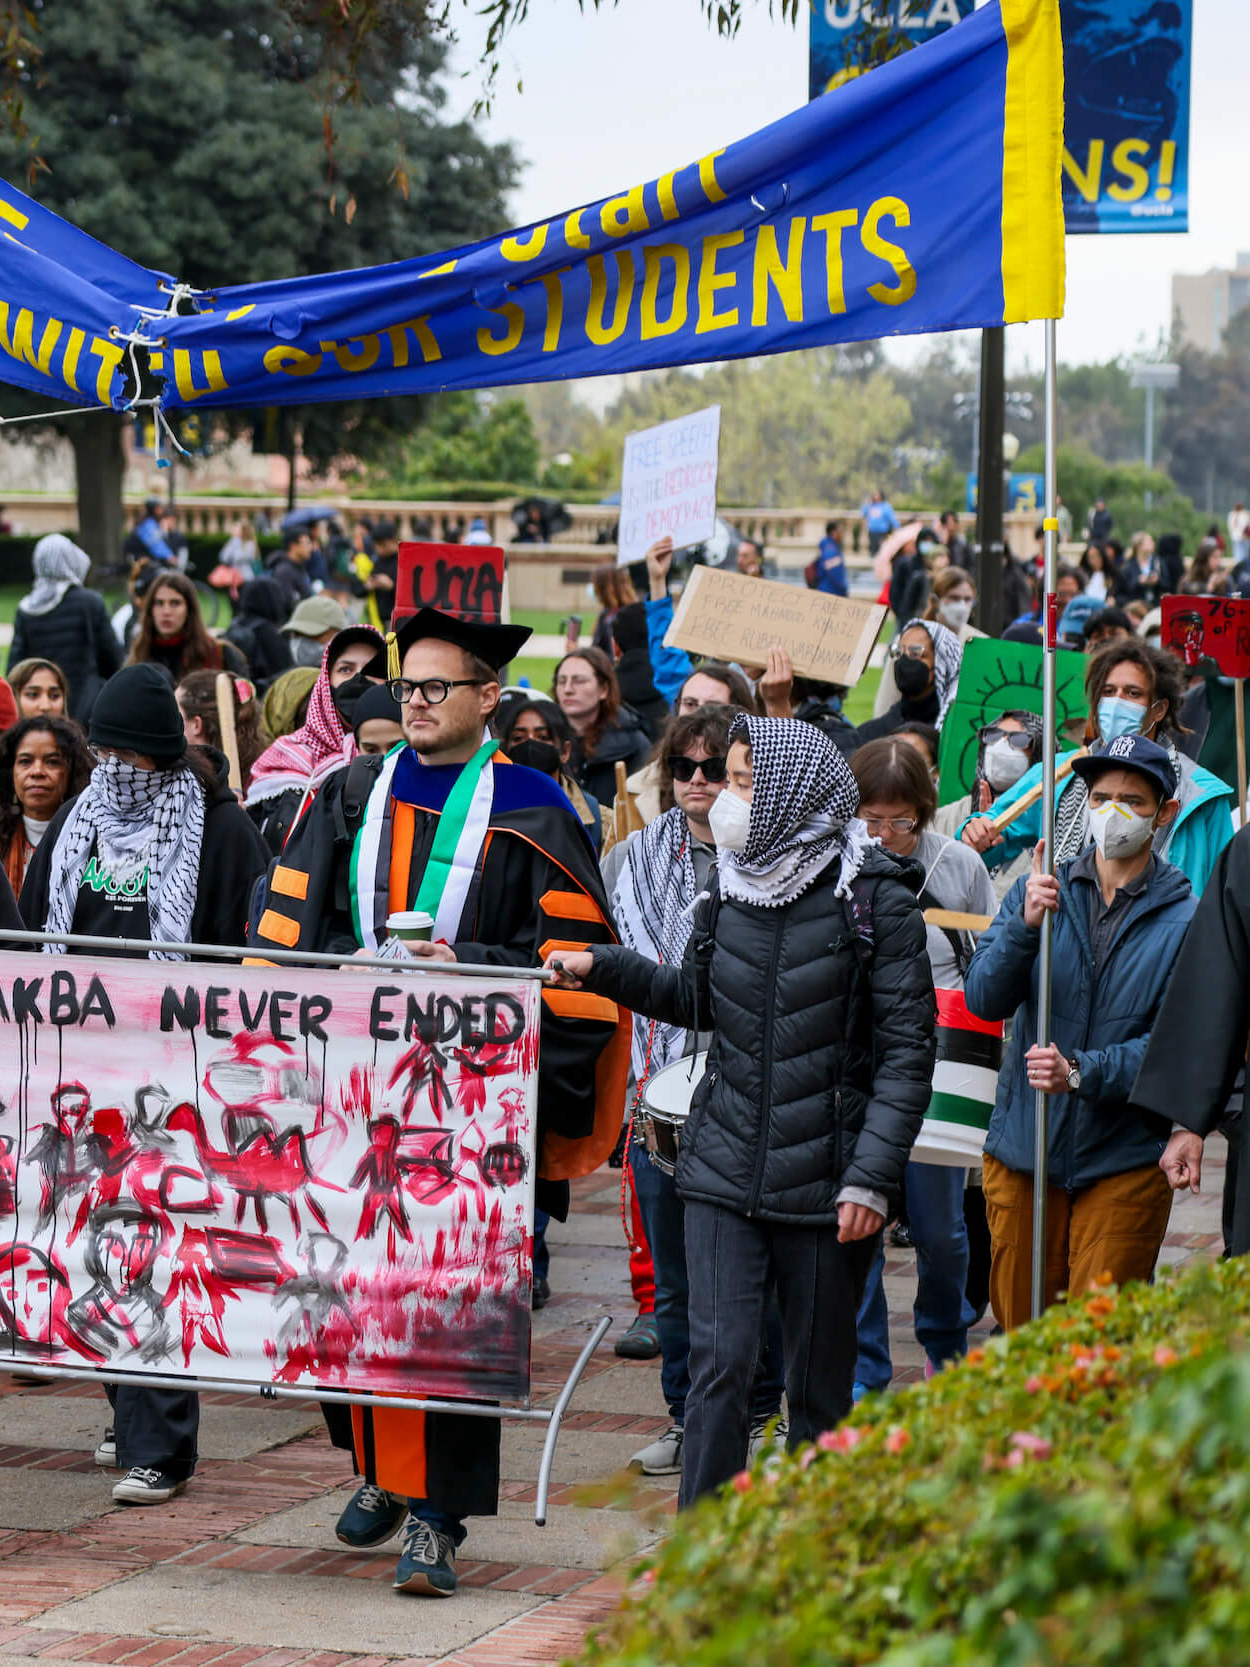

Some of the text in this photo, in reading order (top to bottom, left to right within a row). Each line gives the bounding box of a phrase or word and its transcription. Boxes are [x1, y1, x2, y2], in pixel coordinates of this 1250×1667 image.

[476, 195, 918, 357] STUDENTS
[630, 436, 662, 472] FREE
[645, 495, 715, 540] DEMOCRACY
[702, 593, 744, 615] FREE
[709, 573, 801, 604] PROTECT
[809, 596, 840, 616] FREE
[691, 615, 735, 642] FREE
[161, 985, 333, 1042] NEVER
[370, 985, 526, 1046] ENDED
